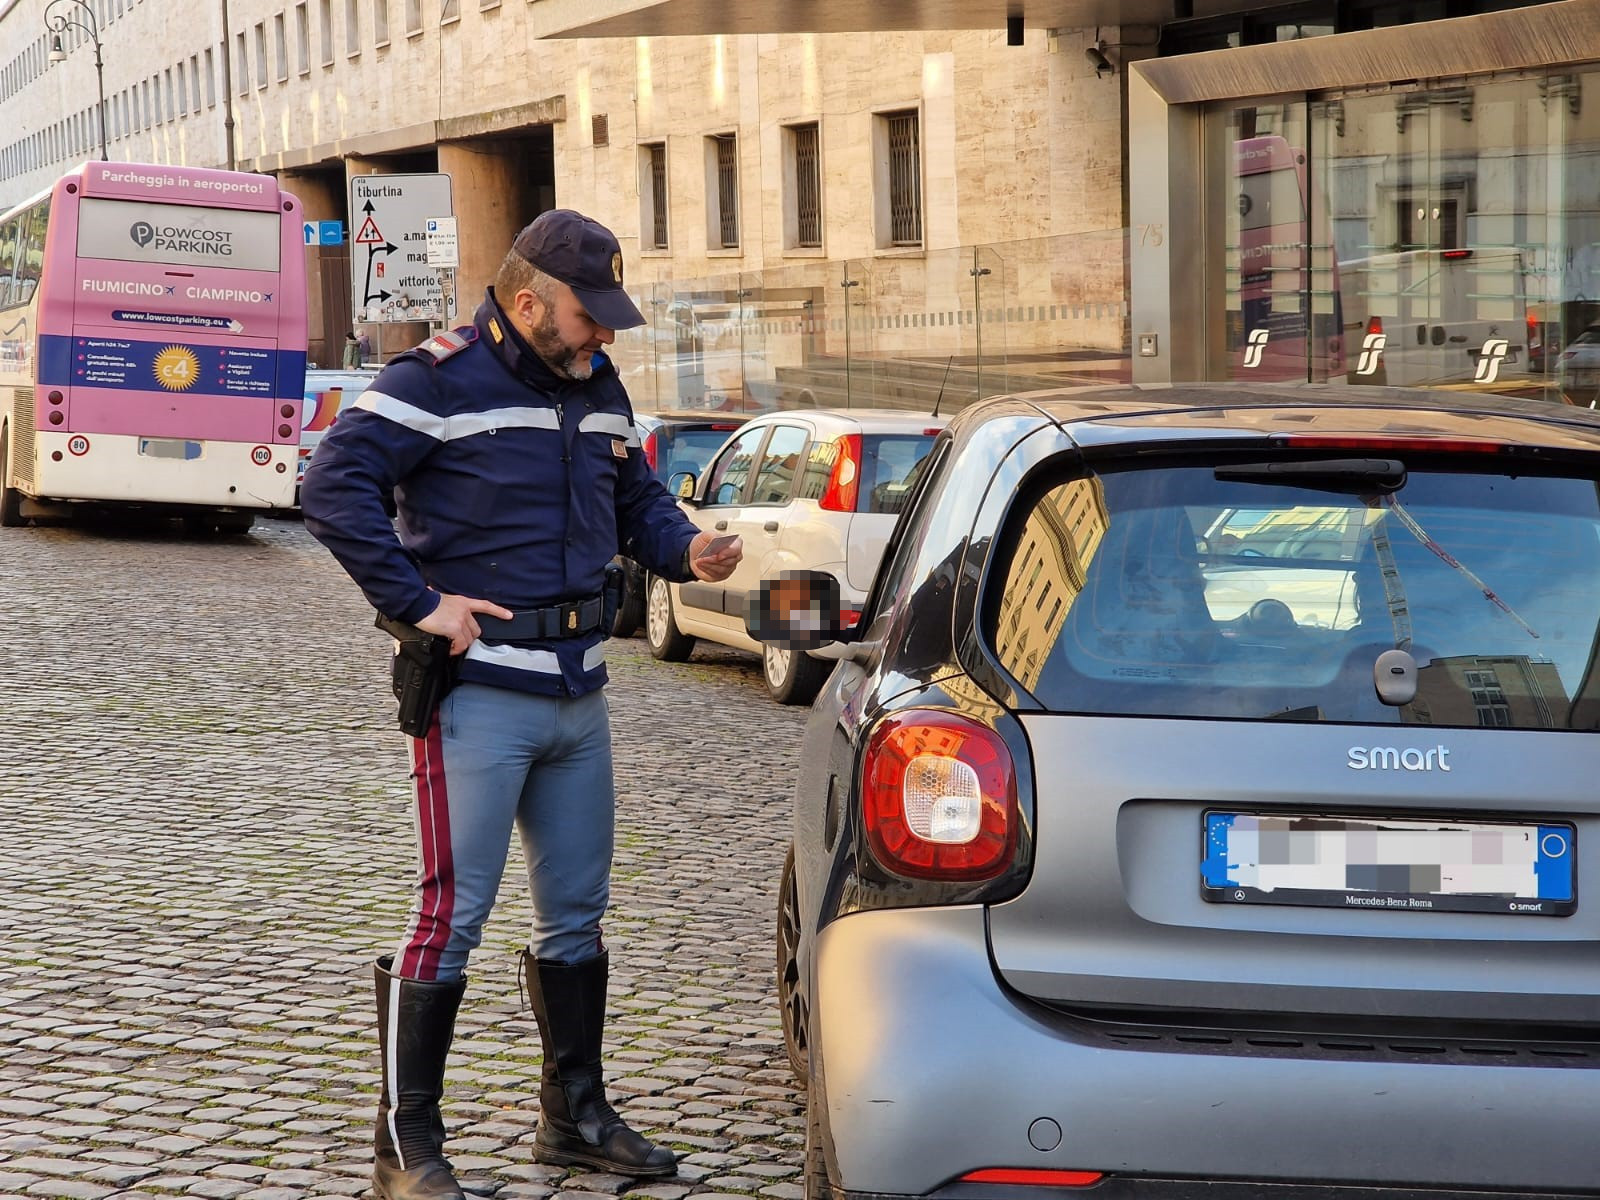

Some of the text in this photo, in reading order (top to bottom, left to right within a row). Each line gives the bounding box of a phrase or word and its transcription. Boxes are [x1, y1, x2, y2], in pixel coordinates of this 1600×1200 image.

[101, 170, 263, 194] Parcheggia in aeroporto!
[357, 185, 402, 198] tiburtina
[155, 226, 233, 242] LOWCOST
[403, 232, 427, 241] a.ma
[1135, 223, 1164, 248] 75
[154, 238, 233, 256] PARKING
[407, 253, 428, 264] mag
[398, 275, 435, 287] vittorio
[82, 279, 262, 303] FIUMICINO CIAMPINO
[121, 311, 223, 327] www.lowcostparking.eu
[73, 440, 85, 450] 80
[255, 451, 269, 461] 100
[1347, 744, 1451, 772] smart
[1345, 895, 1433, 908] Mercedes-Benz Roma
[1517, 903, 1542, 911] smart
